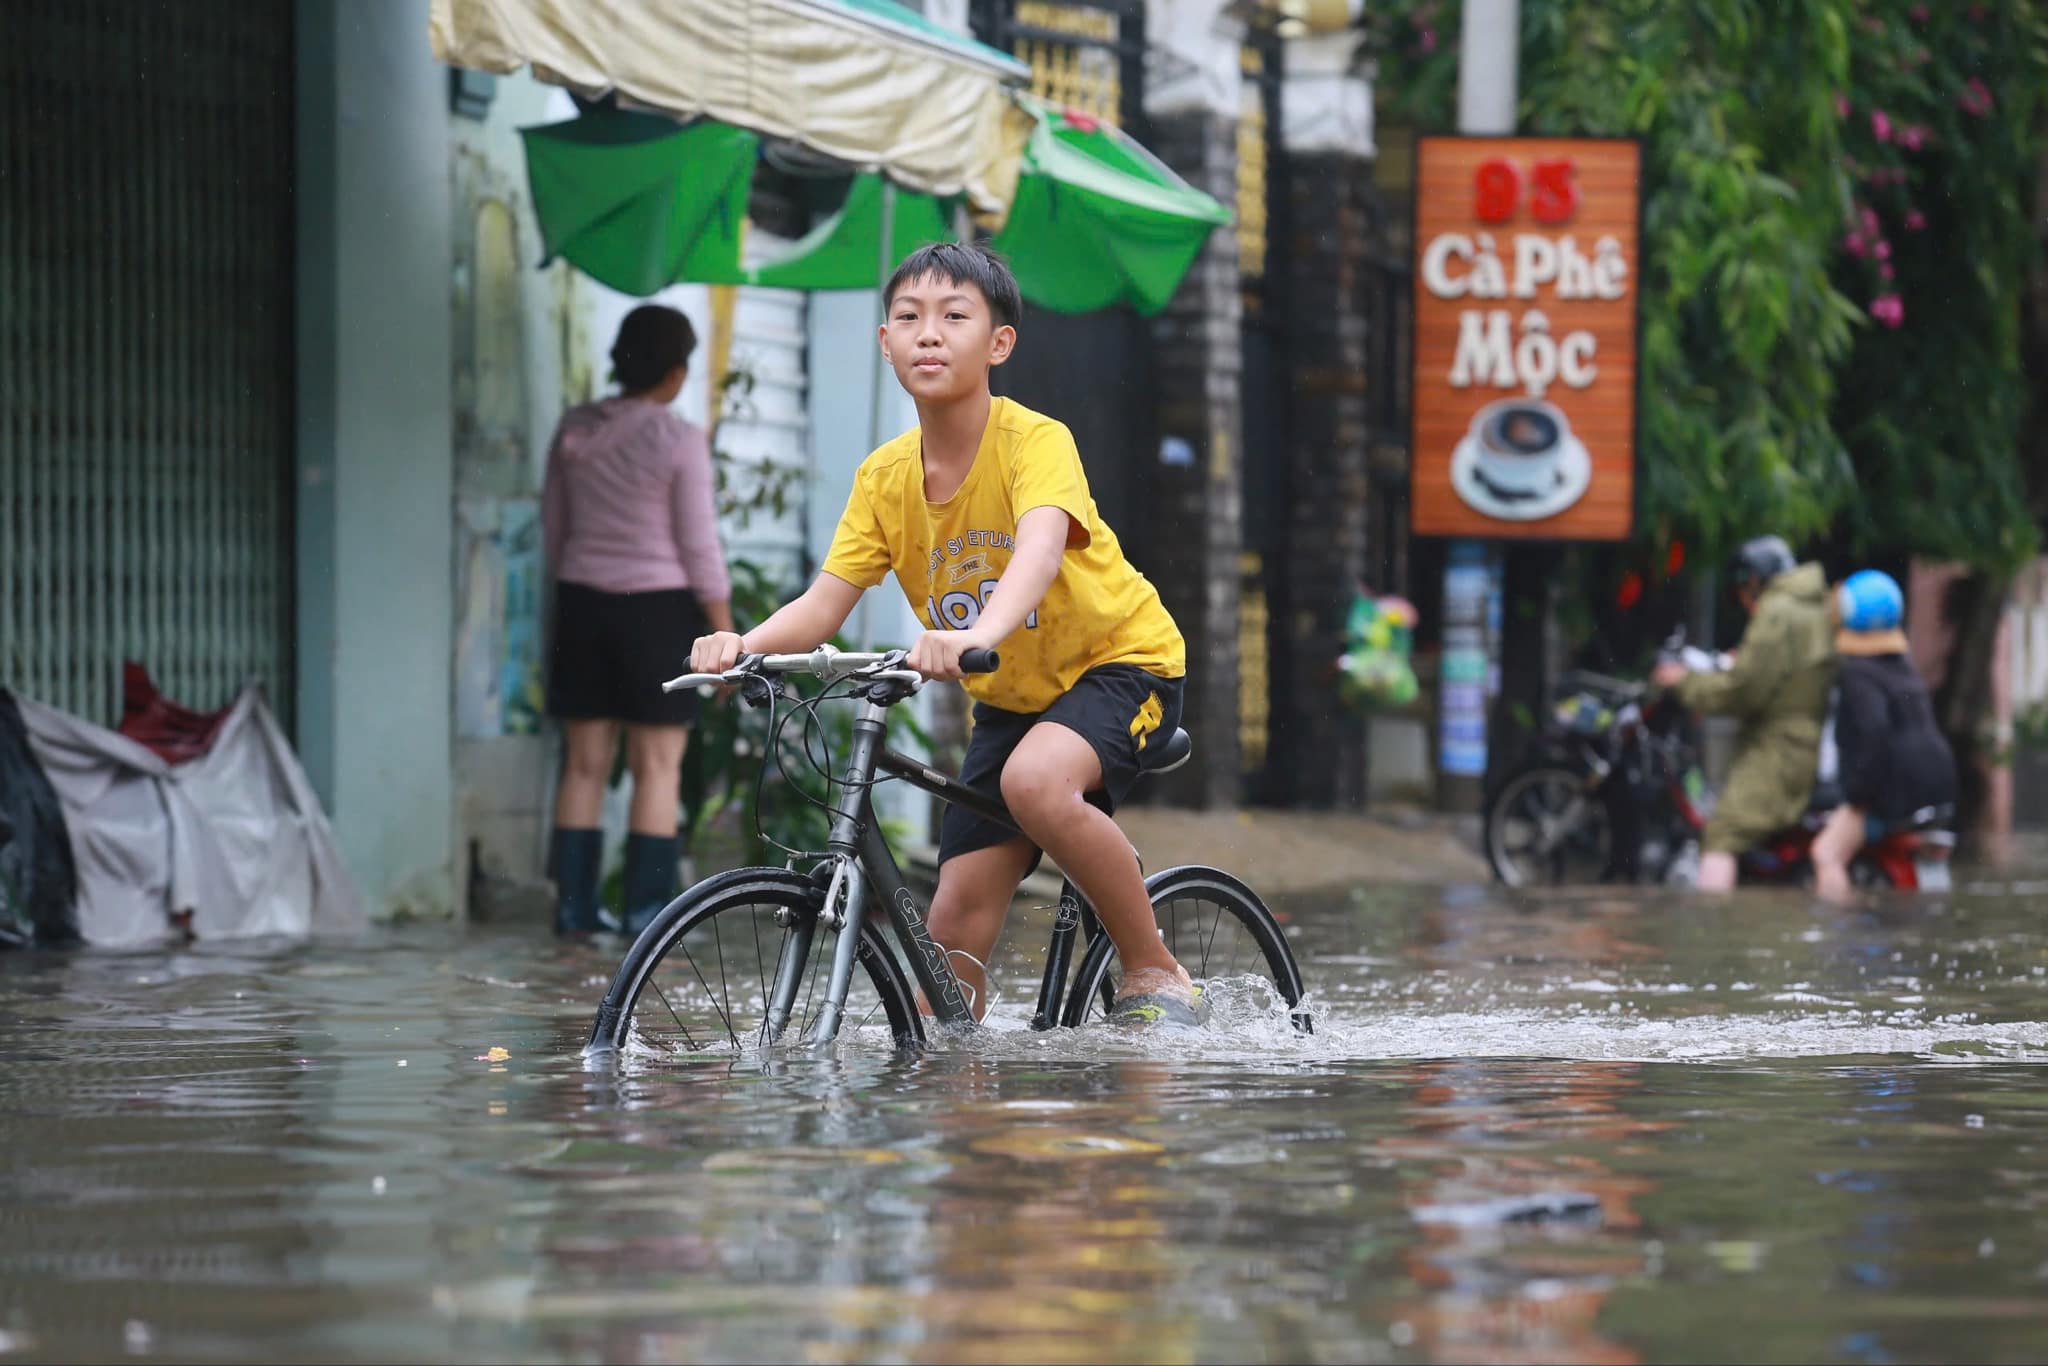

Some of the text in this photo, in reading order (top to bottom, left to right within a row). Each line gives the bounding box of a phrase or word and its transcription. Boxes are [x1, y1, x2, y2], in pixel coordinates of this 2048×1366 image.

[1473, 156, 1578, 223] 95
[1421, 231, 1628, 299] Cà Phê
[1448, 309, 1597, 399] Mộc
[961, 560, 979, 573] THE
